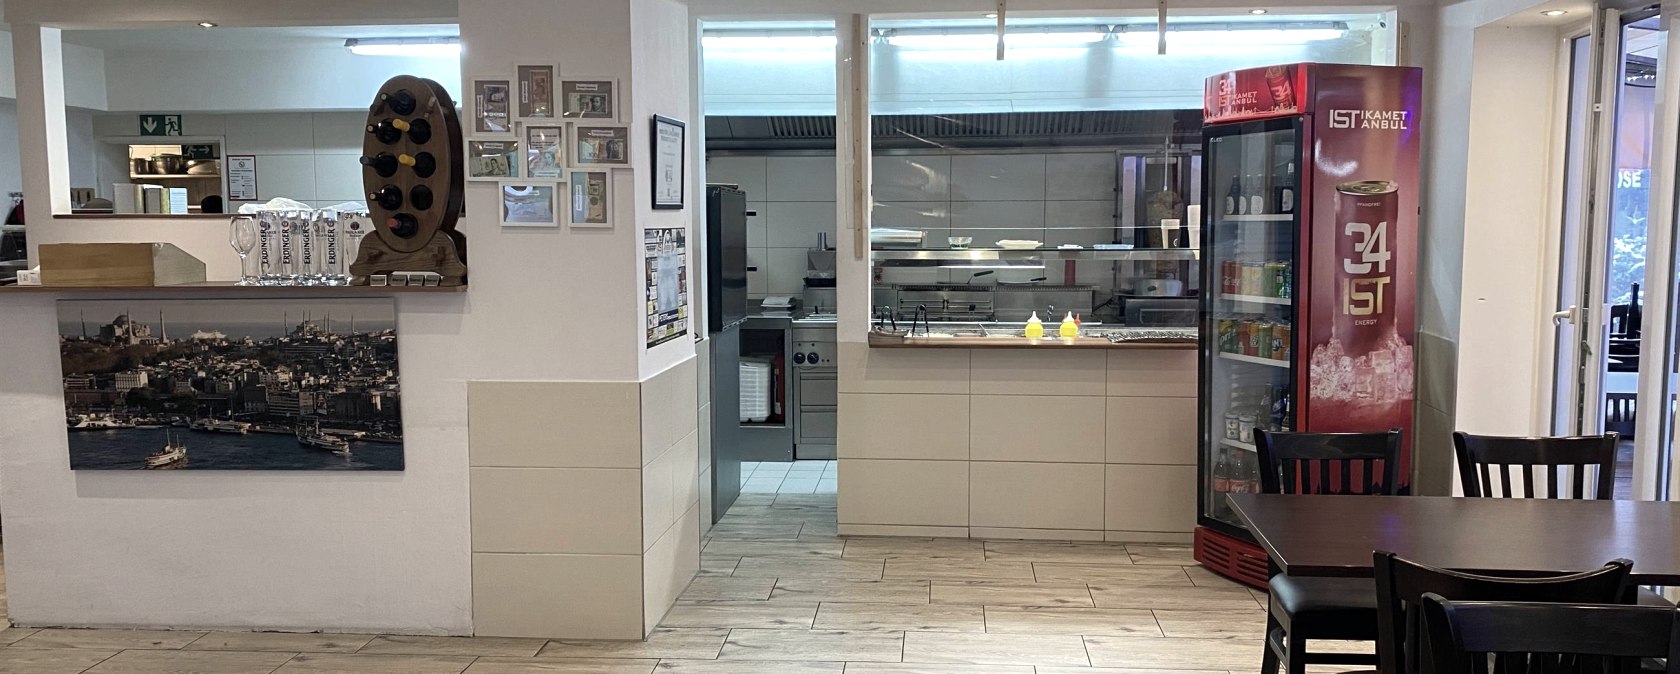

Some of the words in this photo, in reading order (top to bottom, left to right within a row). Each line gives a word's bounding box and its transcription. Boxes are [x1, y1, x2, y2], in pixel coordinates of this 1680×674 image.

[1219, 80, 1232, 95] 34
[1329, 109, 1360, 129] IST
[1361, 110, 1408, 120] IKAMET
[1361, 120, 1408, 130] ANBUL
[283, 228, 291, 264] ERDINGER
[328, 228, 336, 264] ERDINGER
[1343, 221, 1391, 274] 34
[1342, 276, 1391, 316] IST
[1354, 318, 1378, 326] ENERGY
